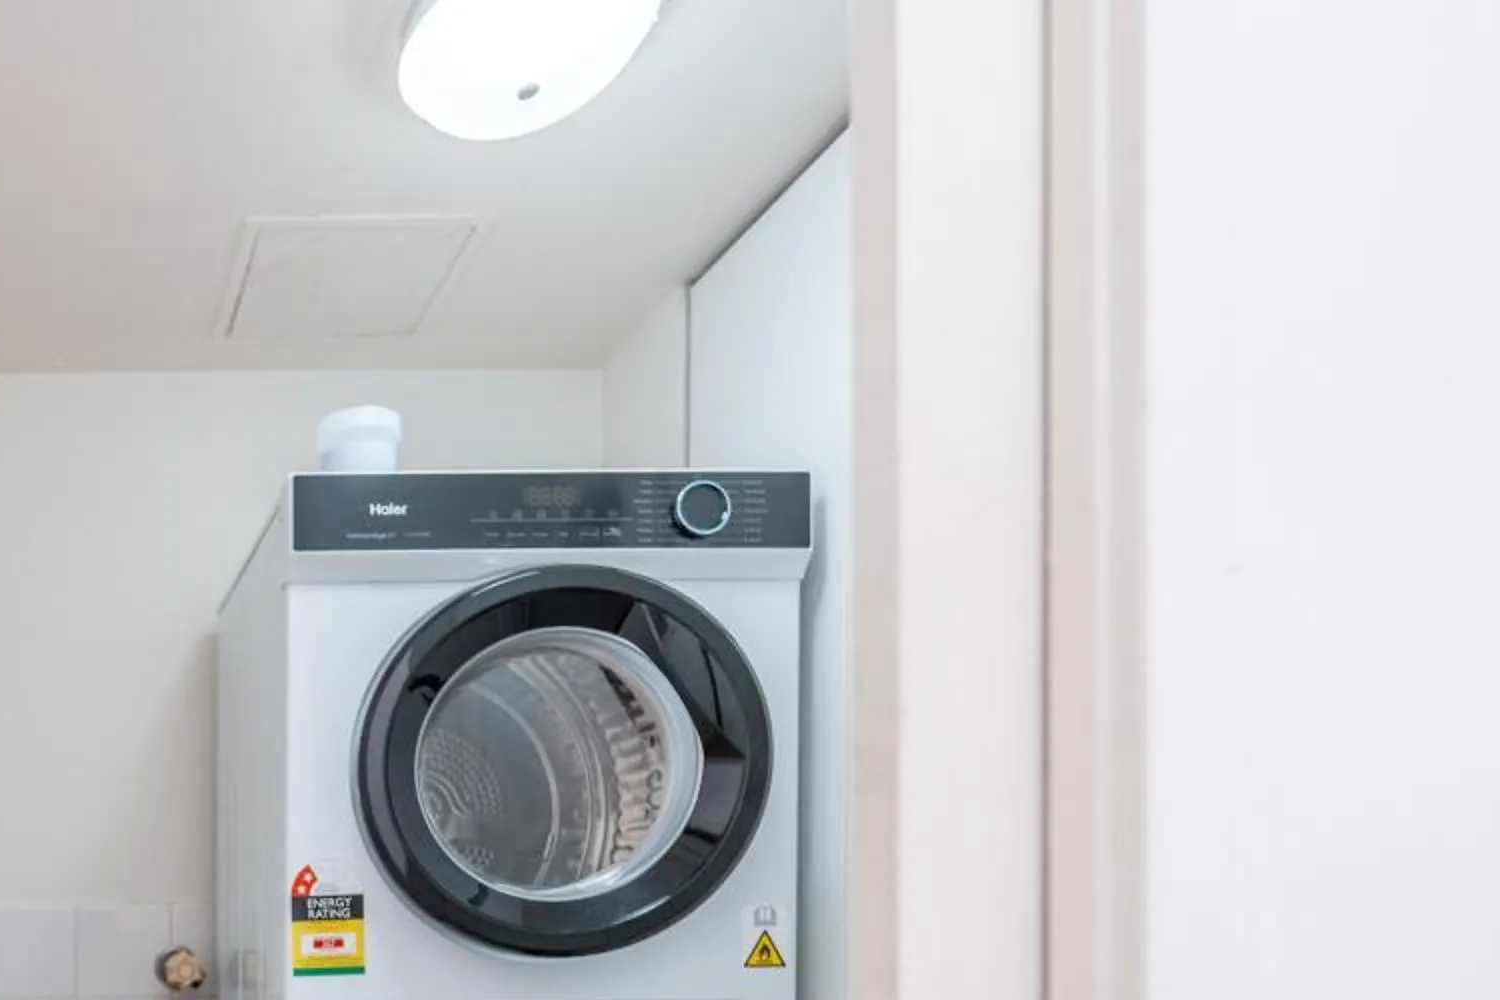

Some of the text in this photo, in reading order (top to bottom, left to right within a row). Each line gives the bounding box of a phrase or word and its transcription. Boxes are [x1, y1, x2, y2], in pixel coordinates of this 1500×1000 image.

[369, 502, 408, 516] Haier
[306, 897, 353, 909] ENERGY
[307, 908, 351, 919] RATING
